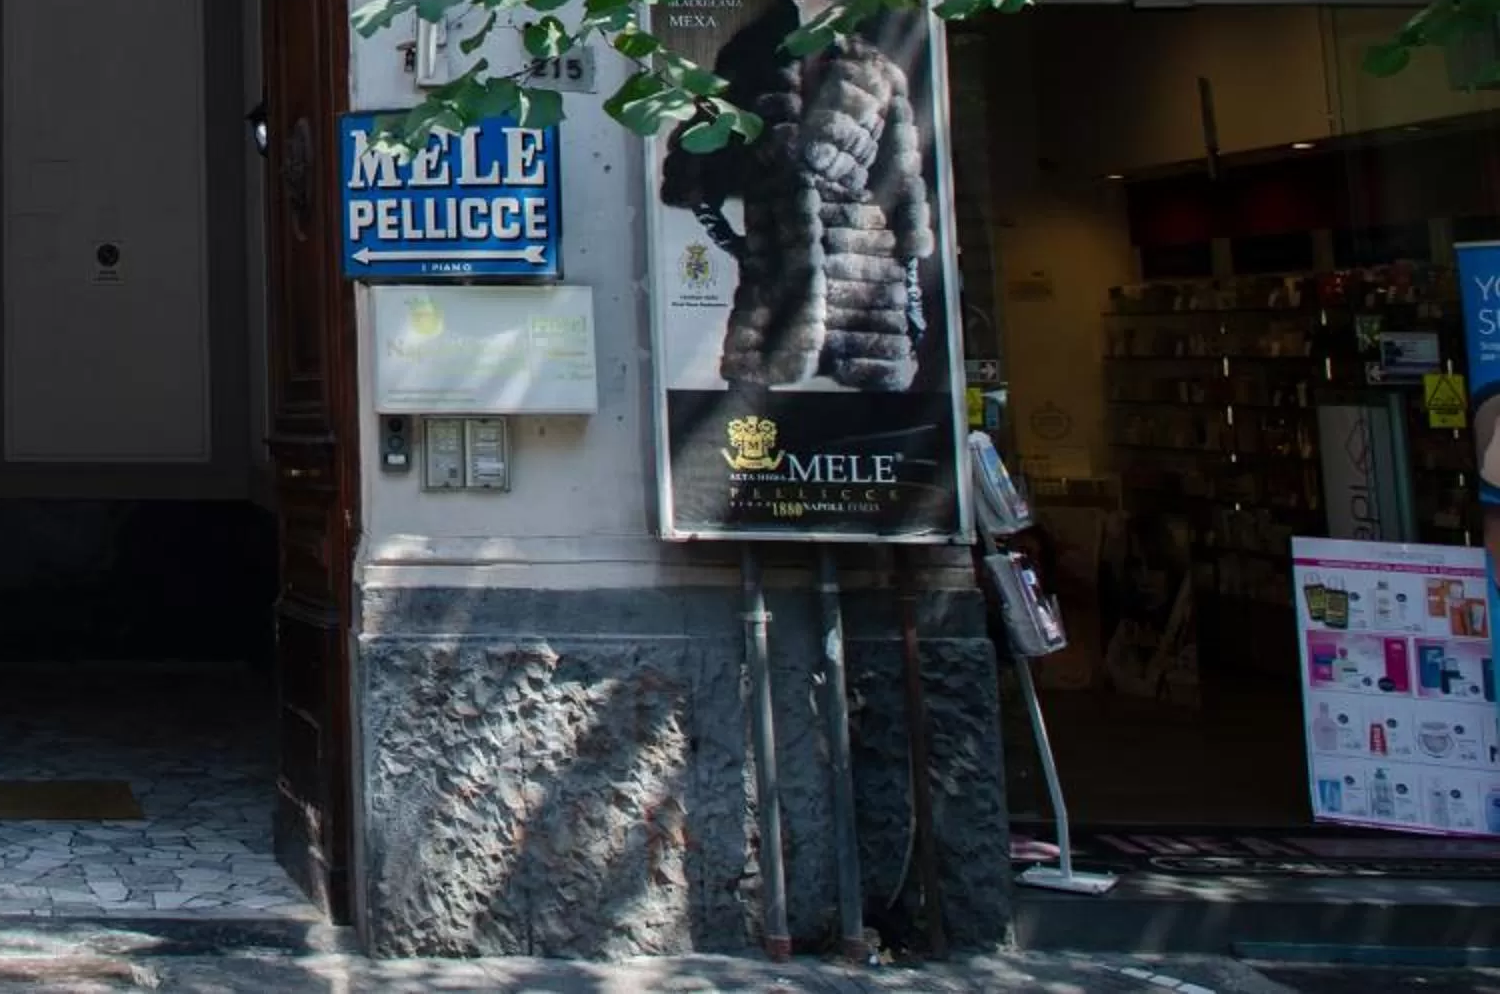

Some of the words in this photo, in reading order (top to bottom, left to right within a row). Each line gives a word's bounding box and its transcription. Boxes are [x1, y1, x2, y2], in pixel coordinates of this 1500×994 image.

[669, 14, 717, 28] MEXA
[531, 56, 583, 80] 215
[348, 125, 546, 188] MELE
[347, 196, 549, 241] PELLICCE
[431, 261, 473, 272] PIANO
[787, 453, 899, 484] MELE
